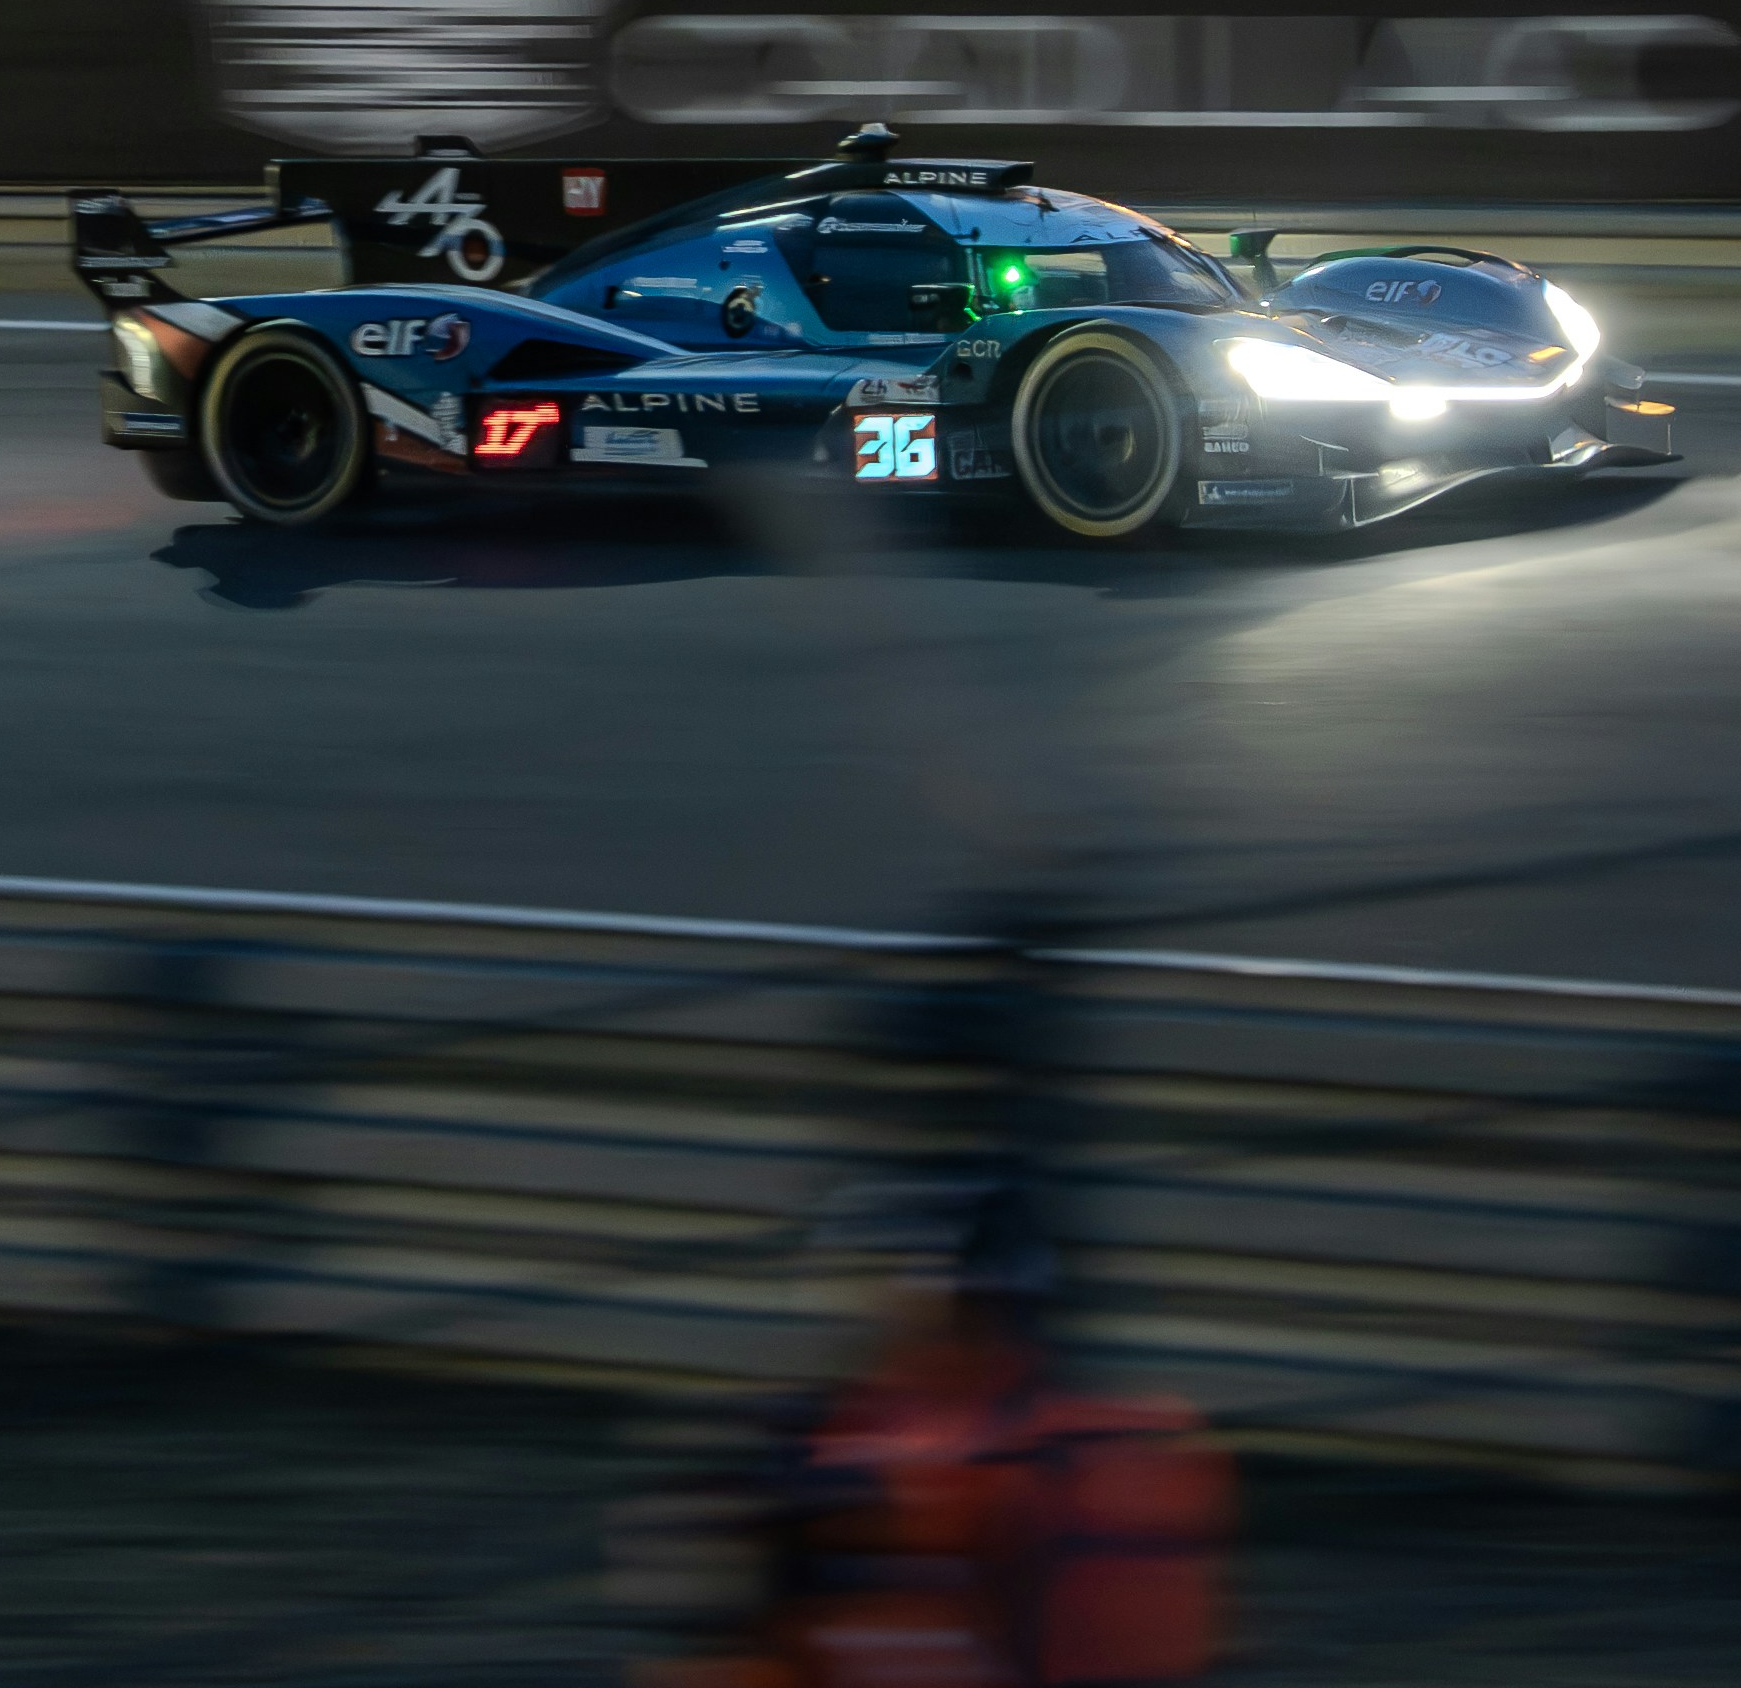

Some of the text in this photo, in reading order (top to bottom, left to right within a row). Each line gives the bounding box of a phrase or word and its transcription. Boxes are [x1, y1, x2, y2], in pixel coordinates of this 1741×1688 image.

[883, 171, 988, 185] ALPINE
[1365, 280, 1415, 302] elf
[351, 319, 427, 355] elf
[581, 392, 761, 413] ALPINE
[474, 402, 559, 454] 17
[854, 415, 937, 478] 36
